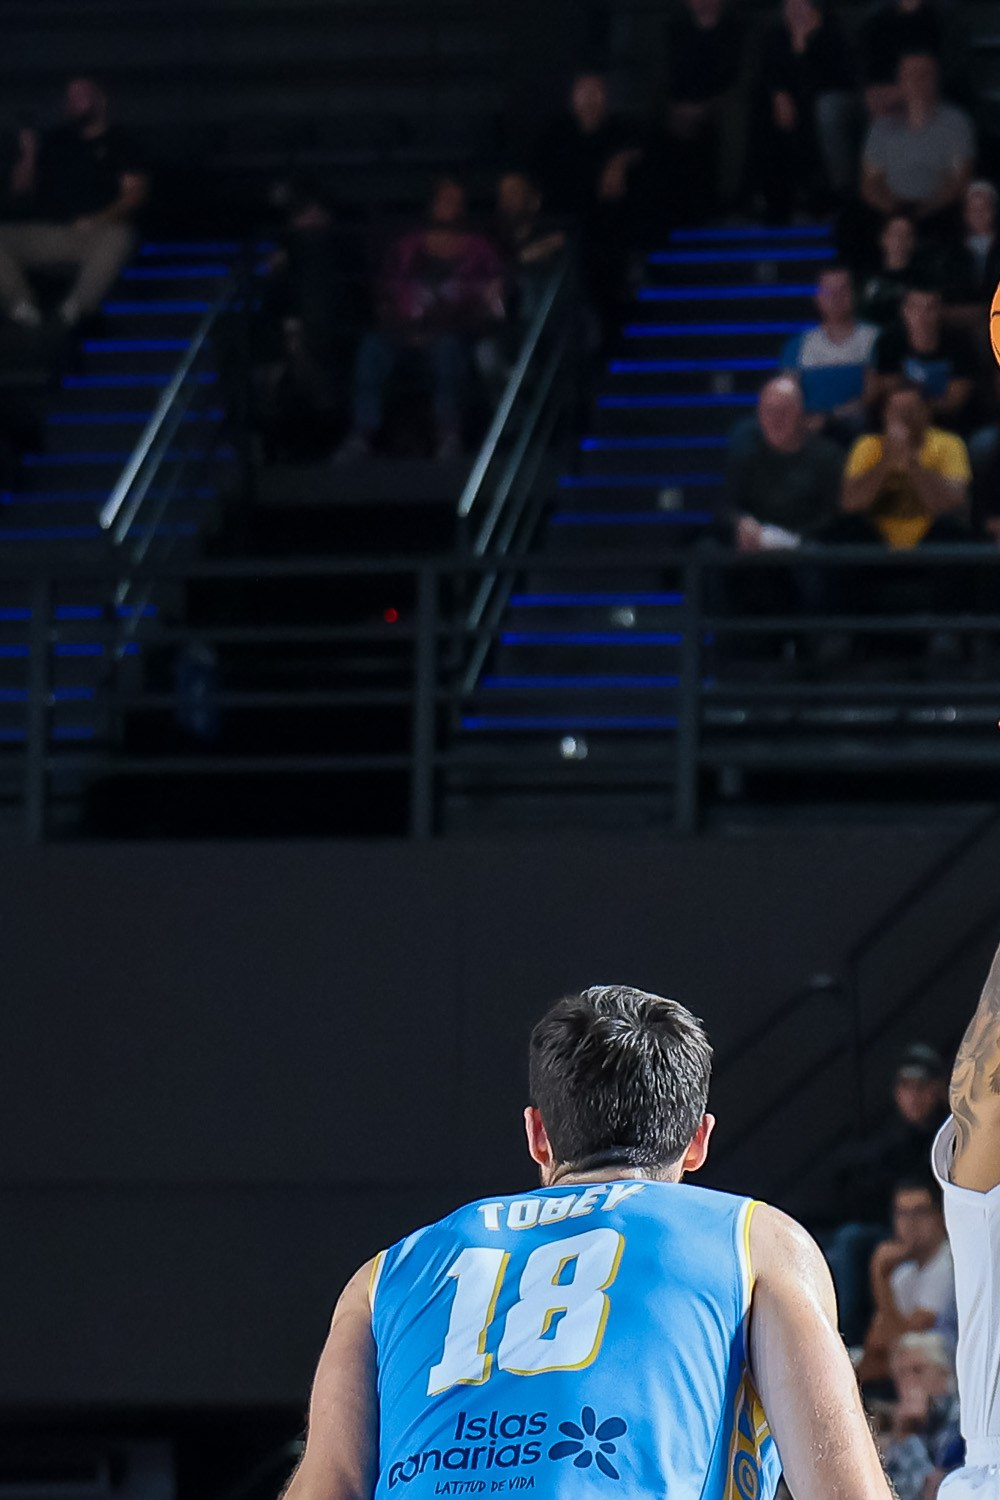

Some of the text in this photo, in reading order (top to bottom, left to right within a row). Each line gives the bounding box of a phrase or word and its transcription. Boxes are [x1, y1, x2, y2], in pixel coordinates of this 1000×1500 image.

[477, 1183, 646, 1230] TOBEY
[426, 1227, 625, 1397] 18
[454, 1410, 549, 1441] Islas
[490, 1480, 507, 1493] DE
[508, 1475, 536, 1490] VIDA
